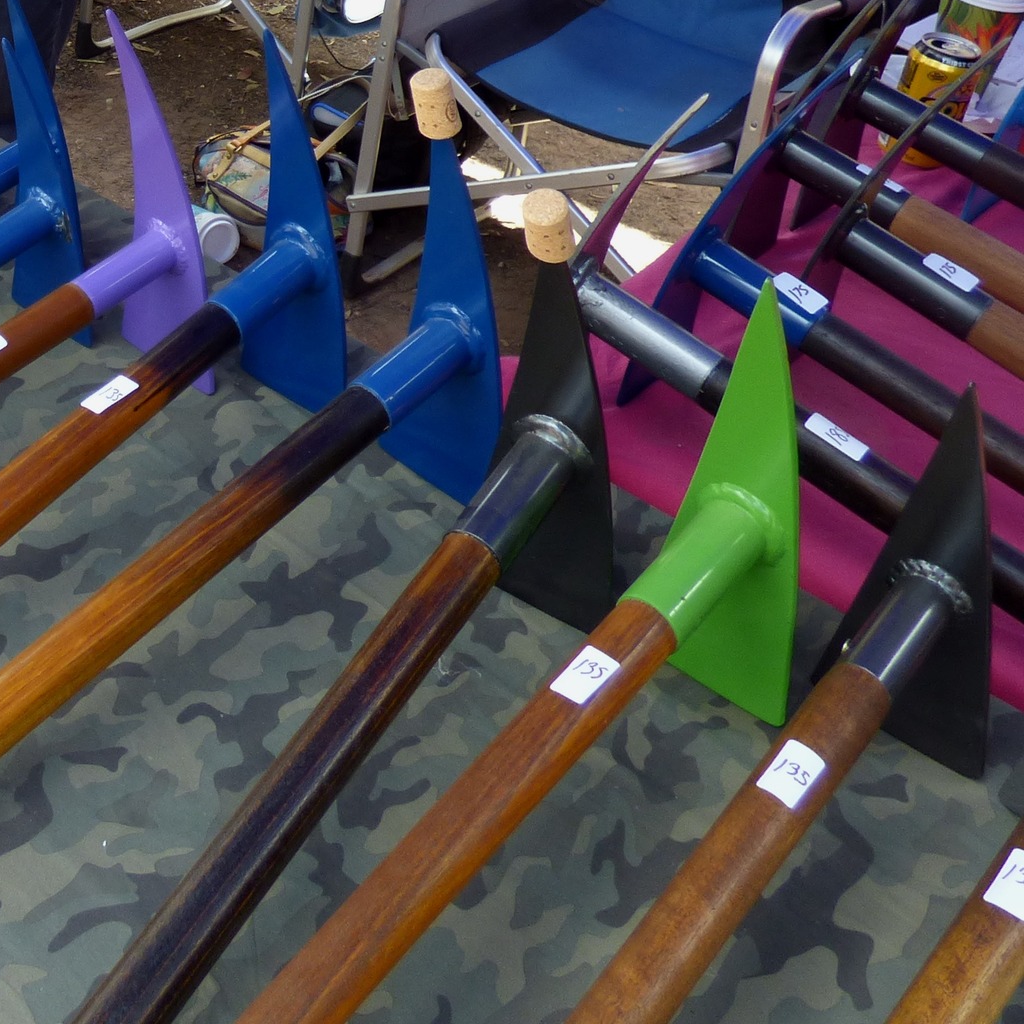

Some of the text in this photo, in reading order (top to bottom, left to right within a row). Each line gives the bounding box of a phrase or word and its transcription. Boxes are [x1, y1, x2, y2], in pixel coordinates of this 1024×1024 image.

[787, 284, 810, 305] 175
[98, 387, 124, 402] 135
[572, 658, 609, 679] 135
[773, 758, 811, 786] 135
